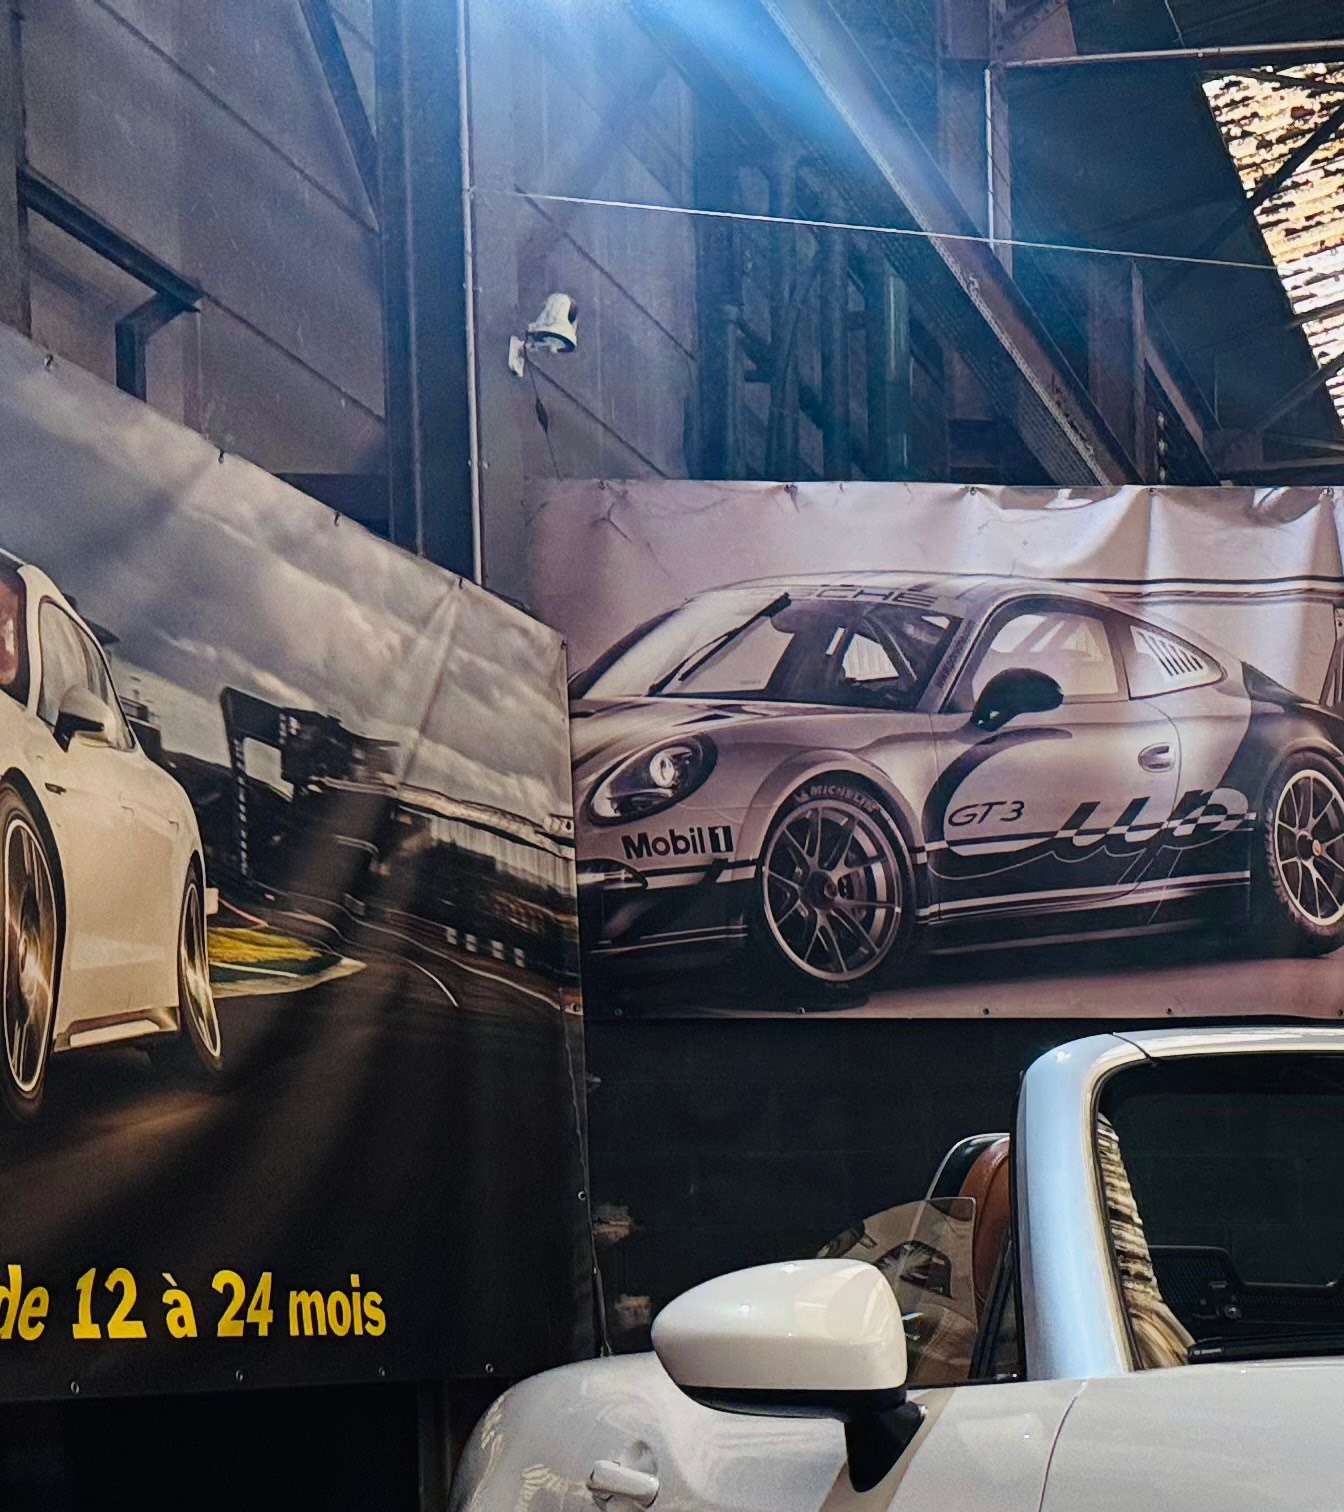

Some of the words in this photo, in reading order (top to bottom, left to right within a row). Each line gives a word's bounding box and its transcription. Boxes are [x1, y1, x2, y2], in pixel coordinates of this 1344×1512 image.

[621, 827, 706, 859] Mobil
[0, 1264, 50, 1341] de
[72, 1267, 148, 1340] 12
[162, 1272, 198, 1340] à
[211, 1269, 274, 1338] 24
[288, 1273, 387, 1338] mois
